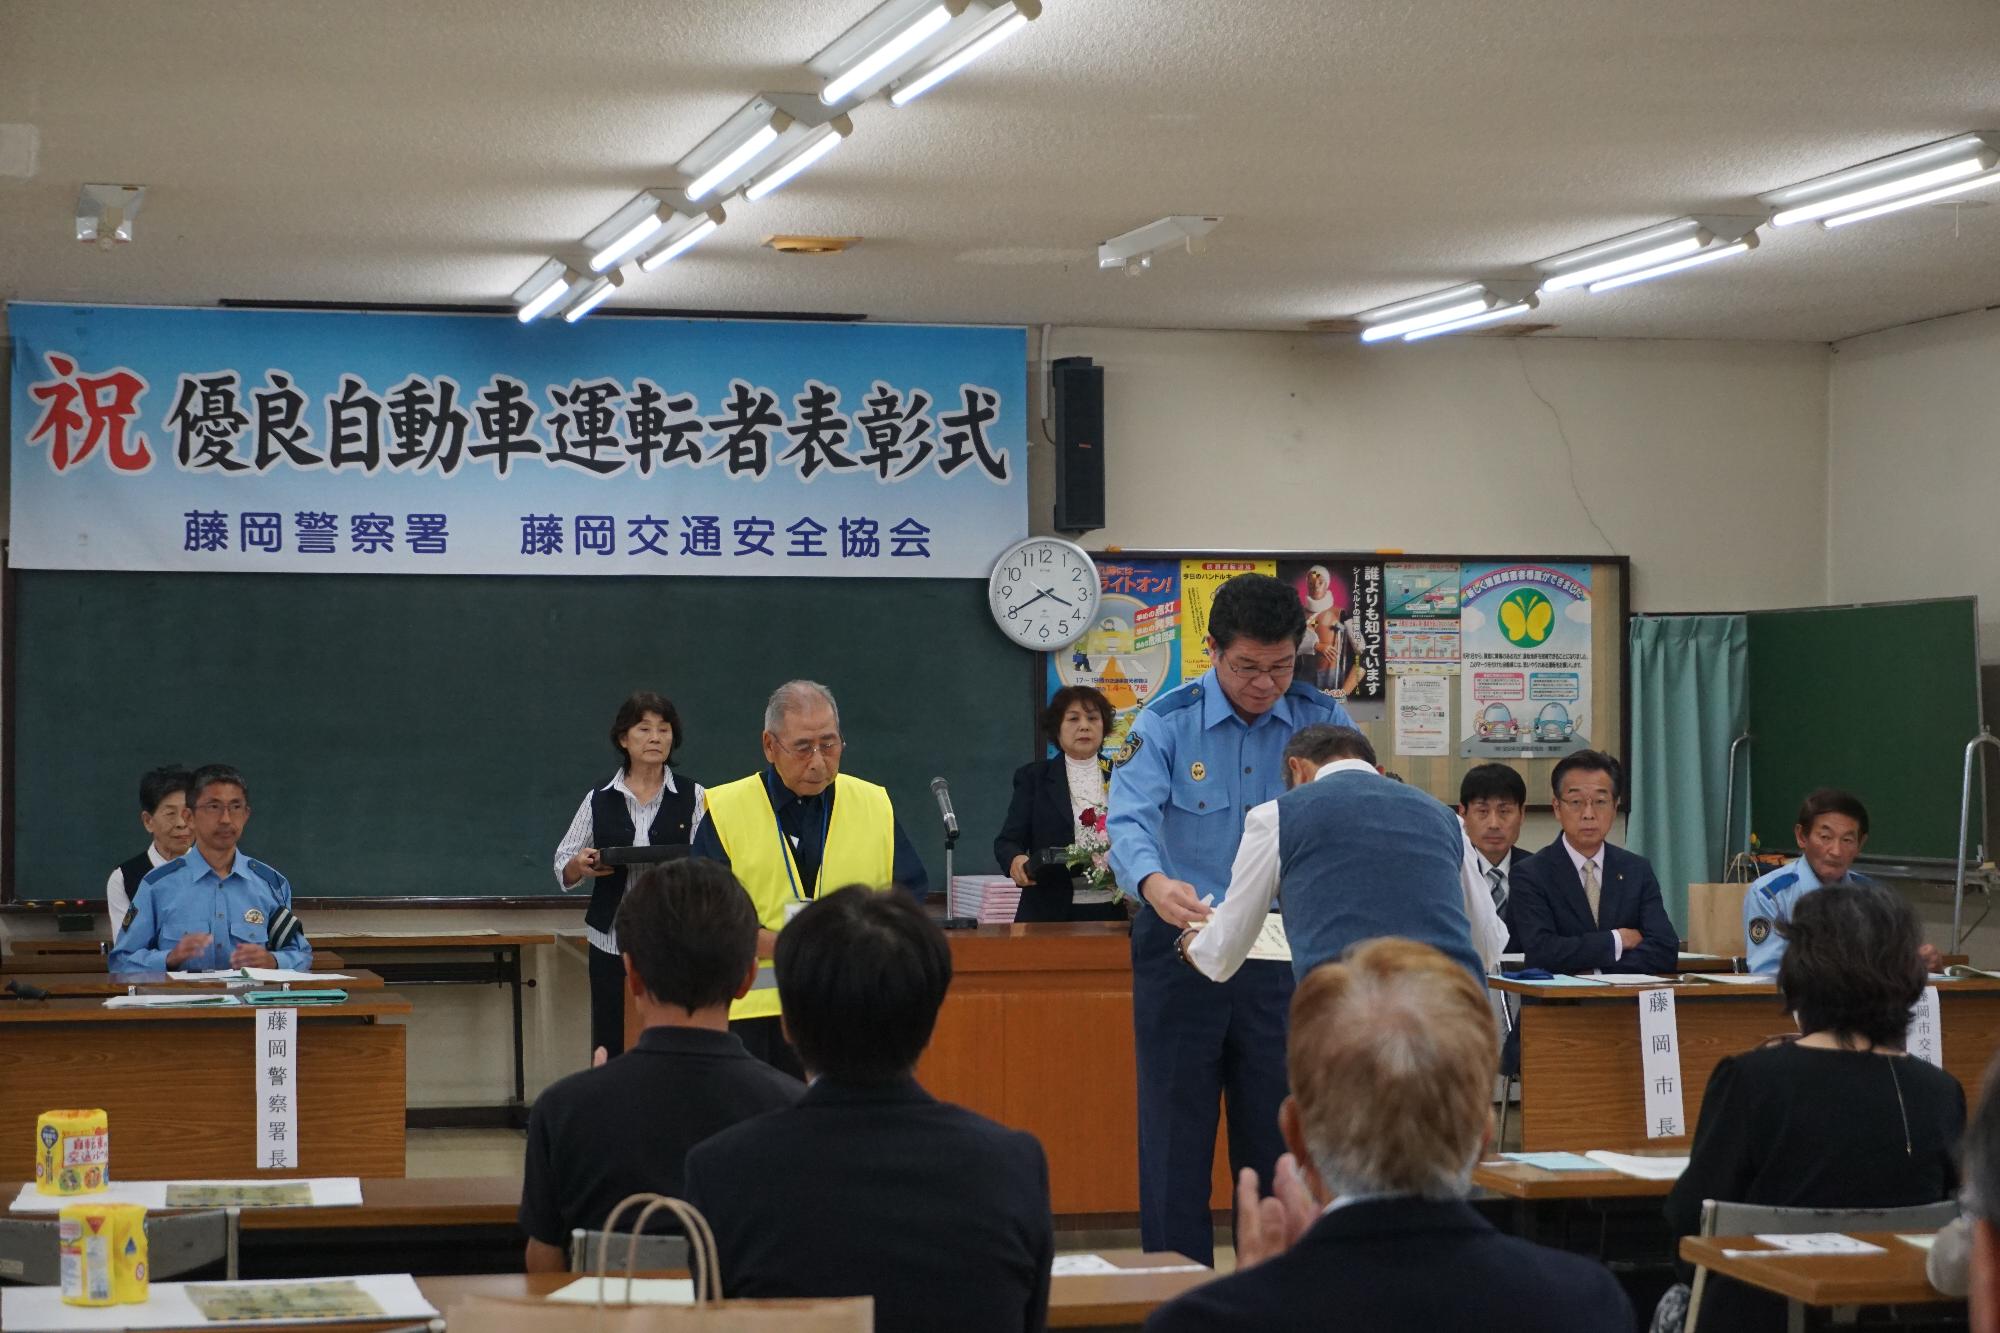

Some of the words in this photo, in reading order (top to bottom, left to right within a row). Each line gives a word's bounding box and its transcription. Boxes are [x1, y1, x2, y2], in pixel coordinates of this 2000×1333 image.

[32, 356, 151, 471] 祝
[168, 374, 1007, 480] 優良自動車運転者表彰式
[184, 510, 449, 554] 藤岡警察署
[520, 513, 931, 558] 藤岡交通安全協会
[1023, 553, 1034, 567] 11
[1039, 549, 1053, 563] 12
[1062, 553, 1066, 567] 1
[1007, 567, 1022, 581] 10
[1072, 567, 1082, 581] 2
[1001, 585, 1013, 599] 9
[1077, 587, 1088, 601] 3
[1007, 605, 1018, 619] 8
[1071, 608, 1081, 620] 4
[1023, 619, 1033, 633] 7
[1038, 624, 1050, 638] 6
[1057, 620, 1069, 634] 5
[1364, 566, 1381, 696] 誰よりも知っています
[1649, 991, 1676, 1136] 藤岡市長
[267, 1010, 288, 1168] 藤岡警察署長
